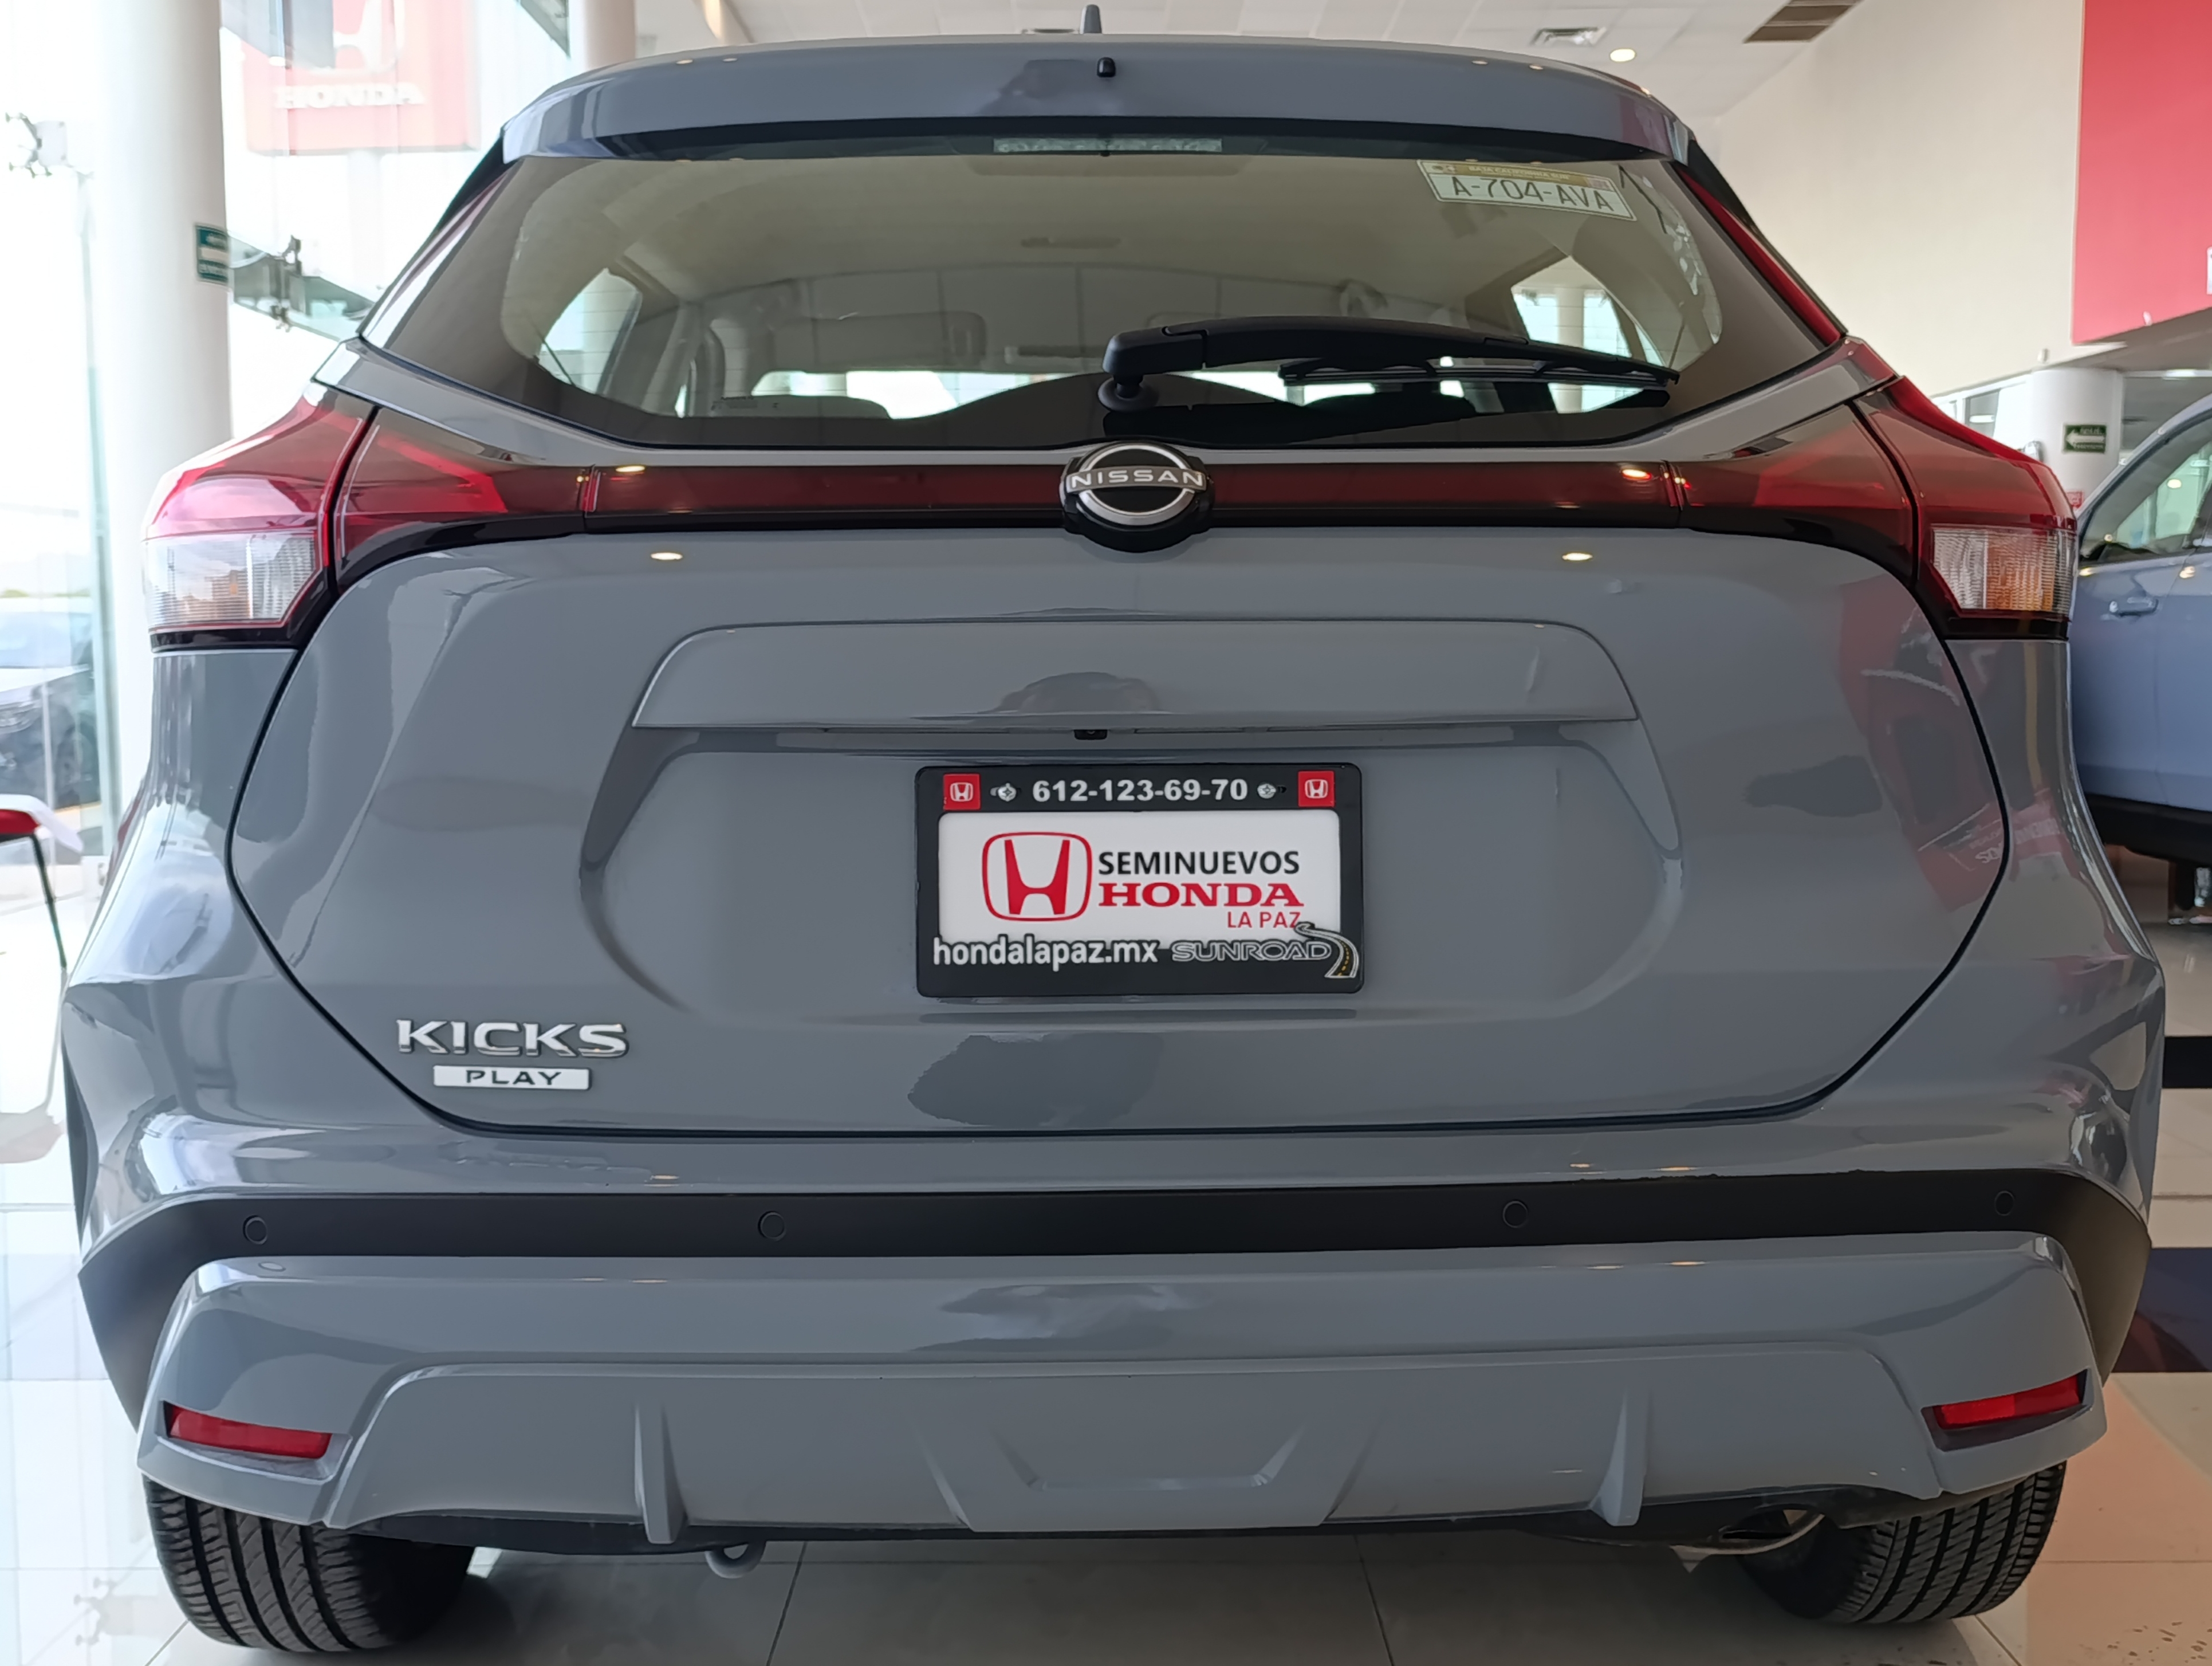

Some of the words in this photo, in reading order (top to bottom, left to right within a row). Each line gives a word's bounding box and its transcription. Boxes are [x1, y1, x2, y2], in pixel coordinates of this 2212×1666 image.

[273, 82, 424, 109] HONDA
[1452, 176, 1614, 211] A-704-AVA
[1071, 469, 1203, 488] NISSAN
[1032, 779, 1249, 802] 612-123-69-70
[1098, 851, 1300, 874] SEMINUEVOS
[1098, 882, 1304, 907] HONDA
[1227, 911, 1253, 928] LA
[1260, 911, 1301, 928] PAZ
[933, 936, 1159, 972] hondalapaz.mx
[1172, 941, 1332, 962] SUNROAD
[396, 1019, 629, 1057] KICKS
[466, 1070, 562, 1086] PLAY
